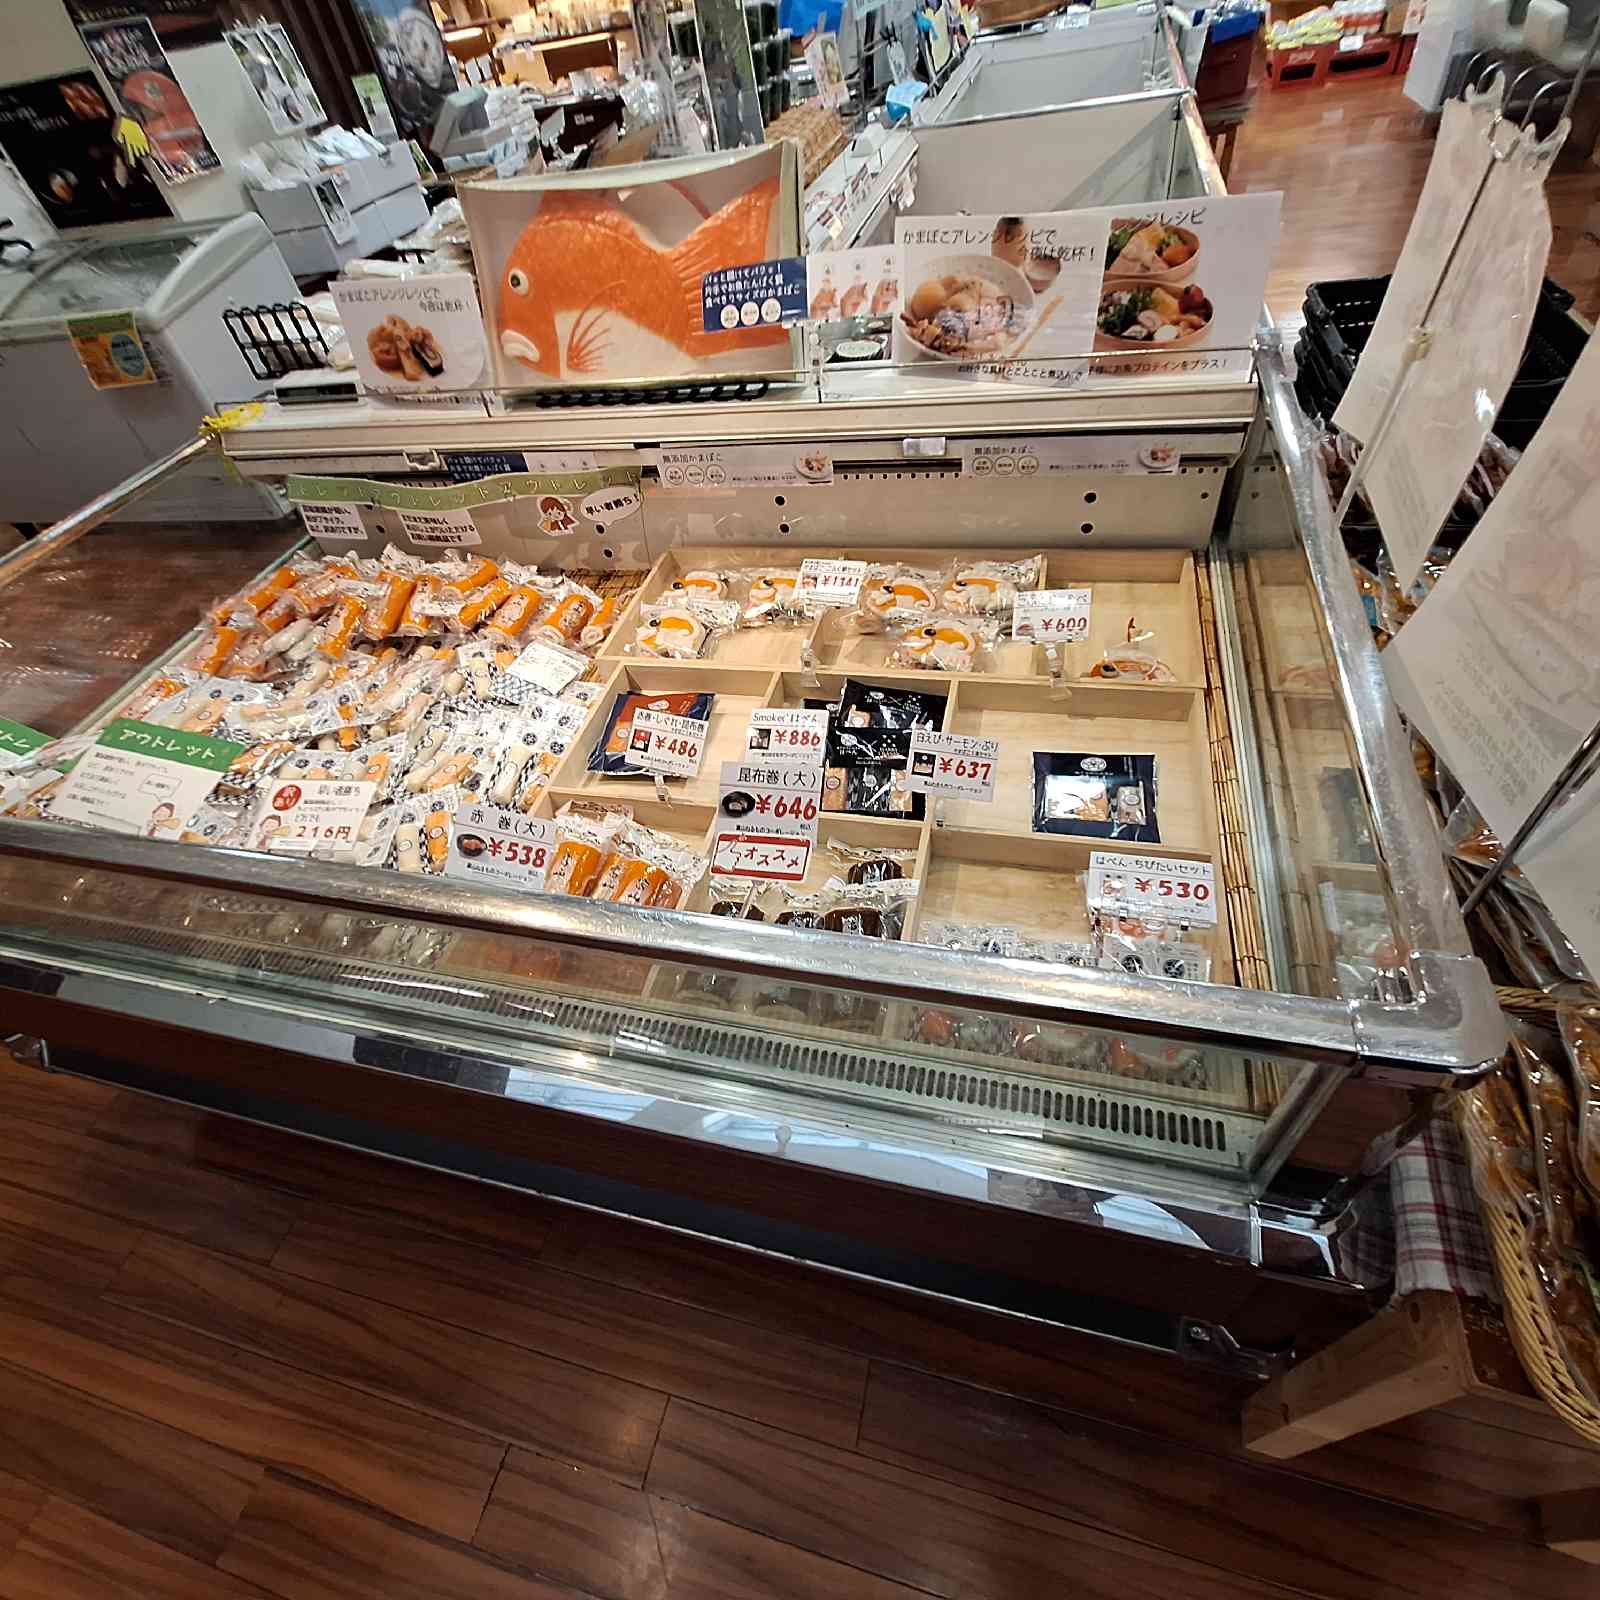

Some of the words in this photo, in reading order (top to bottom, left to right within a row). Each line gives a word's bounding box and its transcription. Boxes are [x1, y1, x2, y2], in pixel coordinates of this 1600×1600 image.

[120, 728, 216, 760] アウトレット
[655, 735, 698, 758] ¥486
[774, 729, 821, 746] ¥886
[939, 757, 992, 781] ¥637
[756, 794, 817, 820] ¥646
[296, 825, 351, 840] 216円
[488, 836, 546, 868] ¥538
[744, 847, 799, 868] オススメ
[1135, 877, 1209, 901] ¥530
